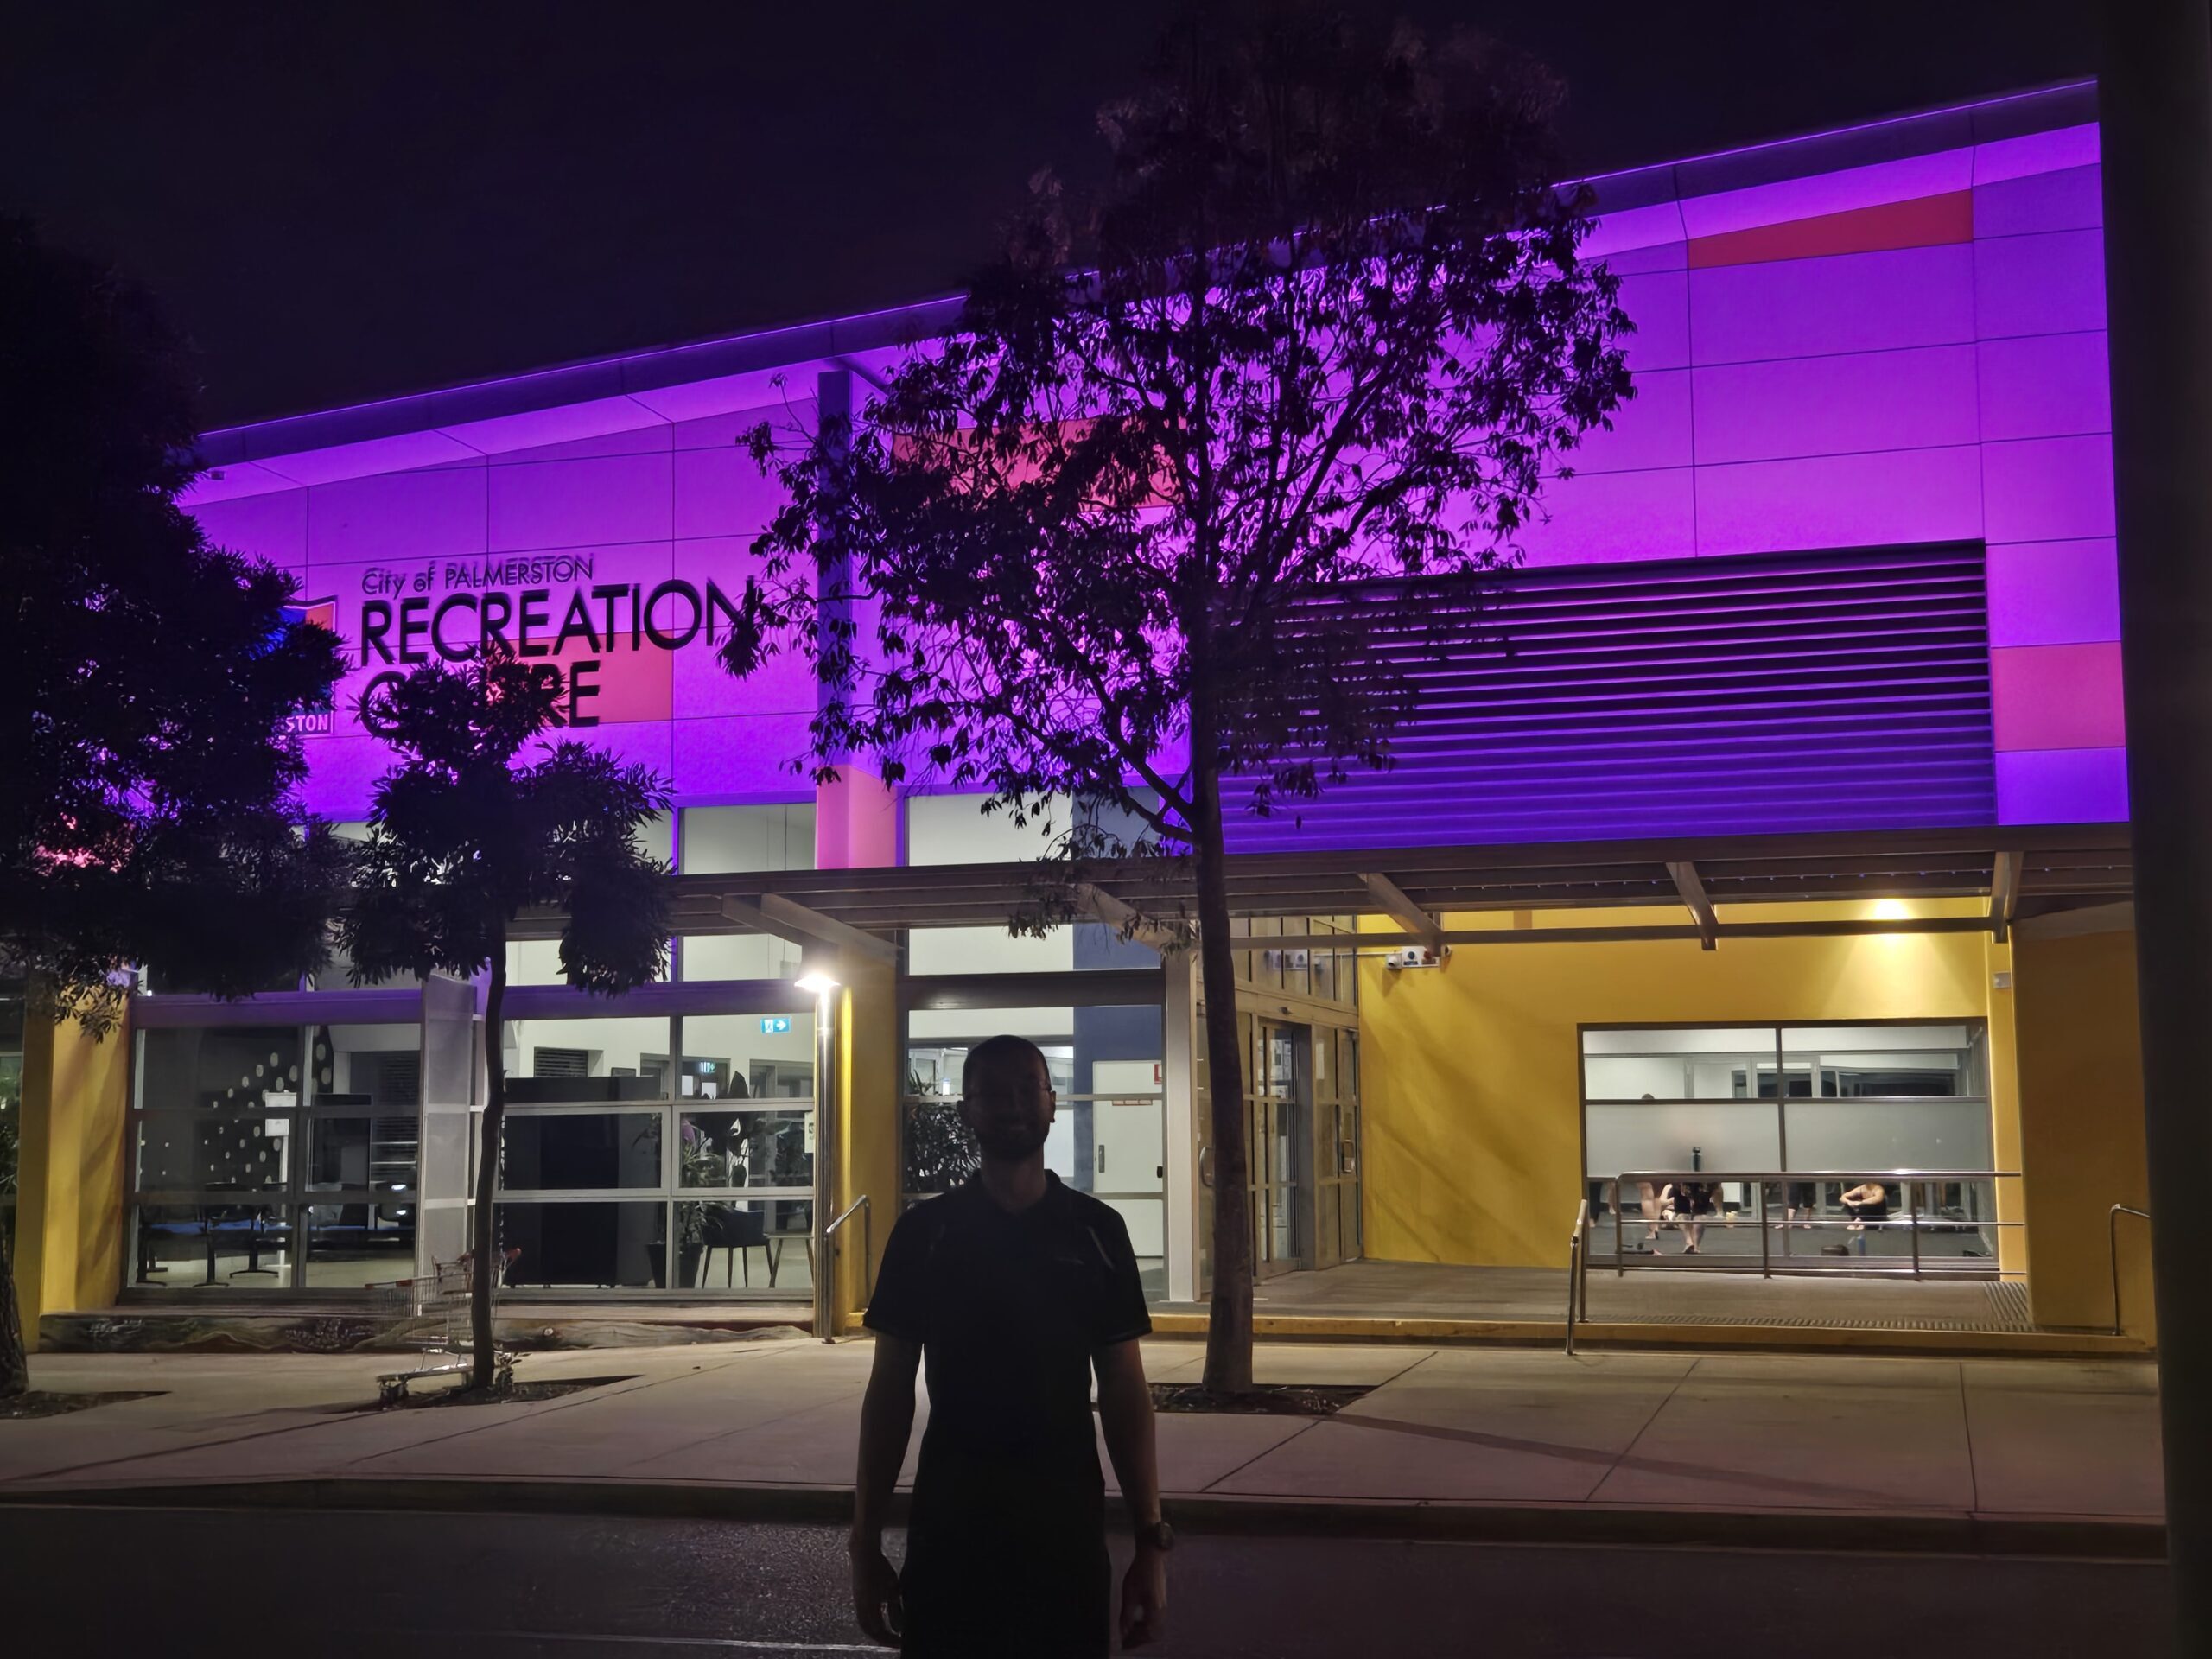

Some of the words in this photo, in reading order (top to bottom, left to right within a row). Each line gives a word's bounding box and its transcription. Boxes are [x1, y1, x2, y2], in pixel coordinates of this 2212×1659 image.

[361, 568, 405, 600] City
[413, 561, 435, 593] of
[445, 553, 594, 589] PALMERSTON
[361, 576, 754, 666] RECREATION
[286, 714, 328, 733] STON
